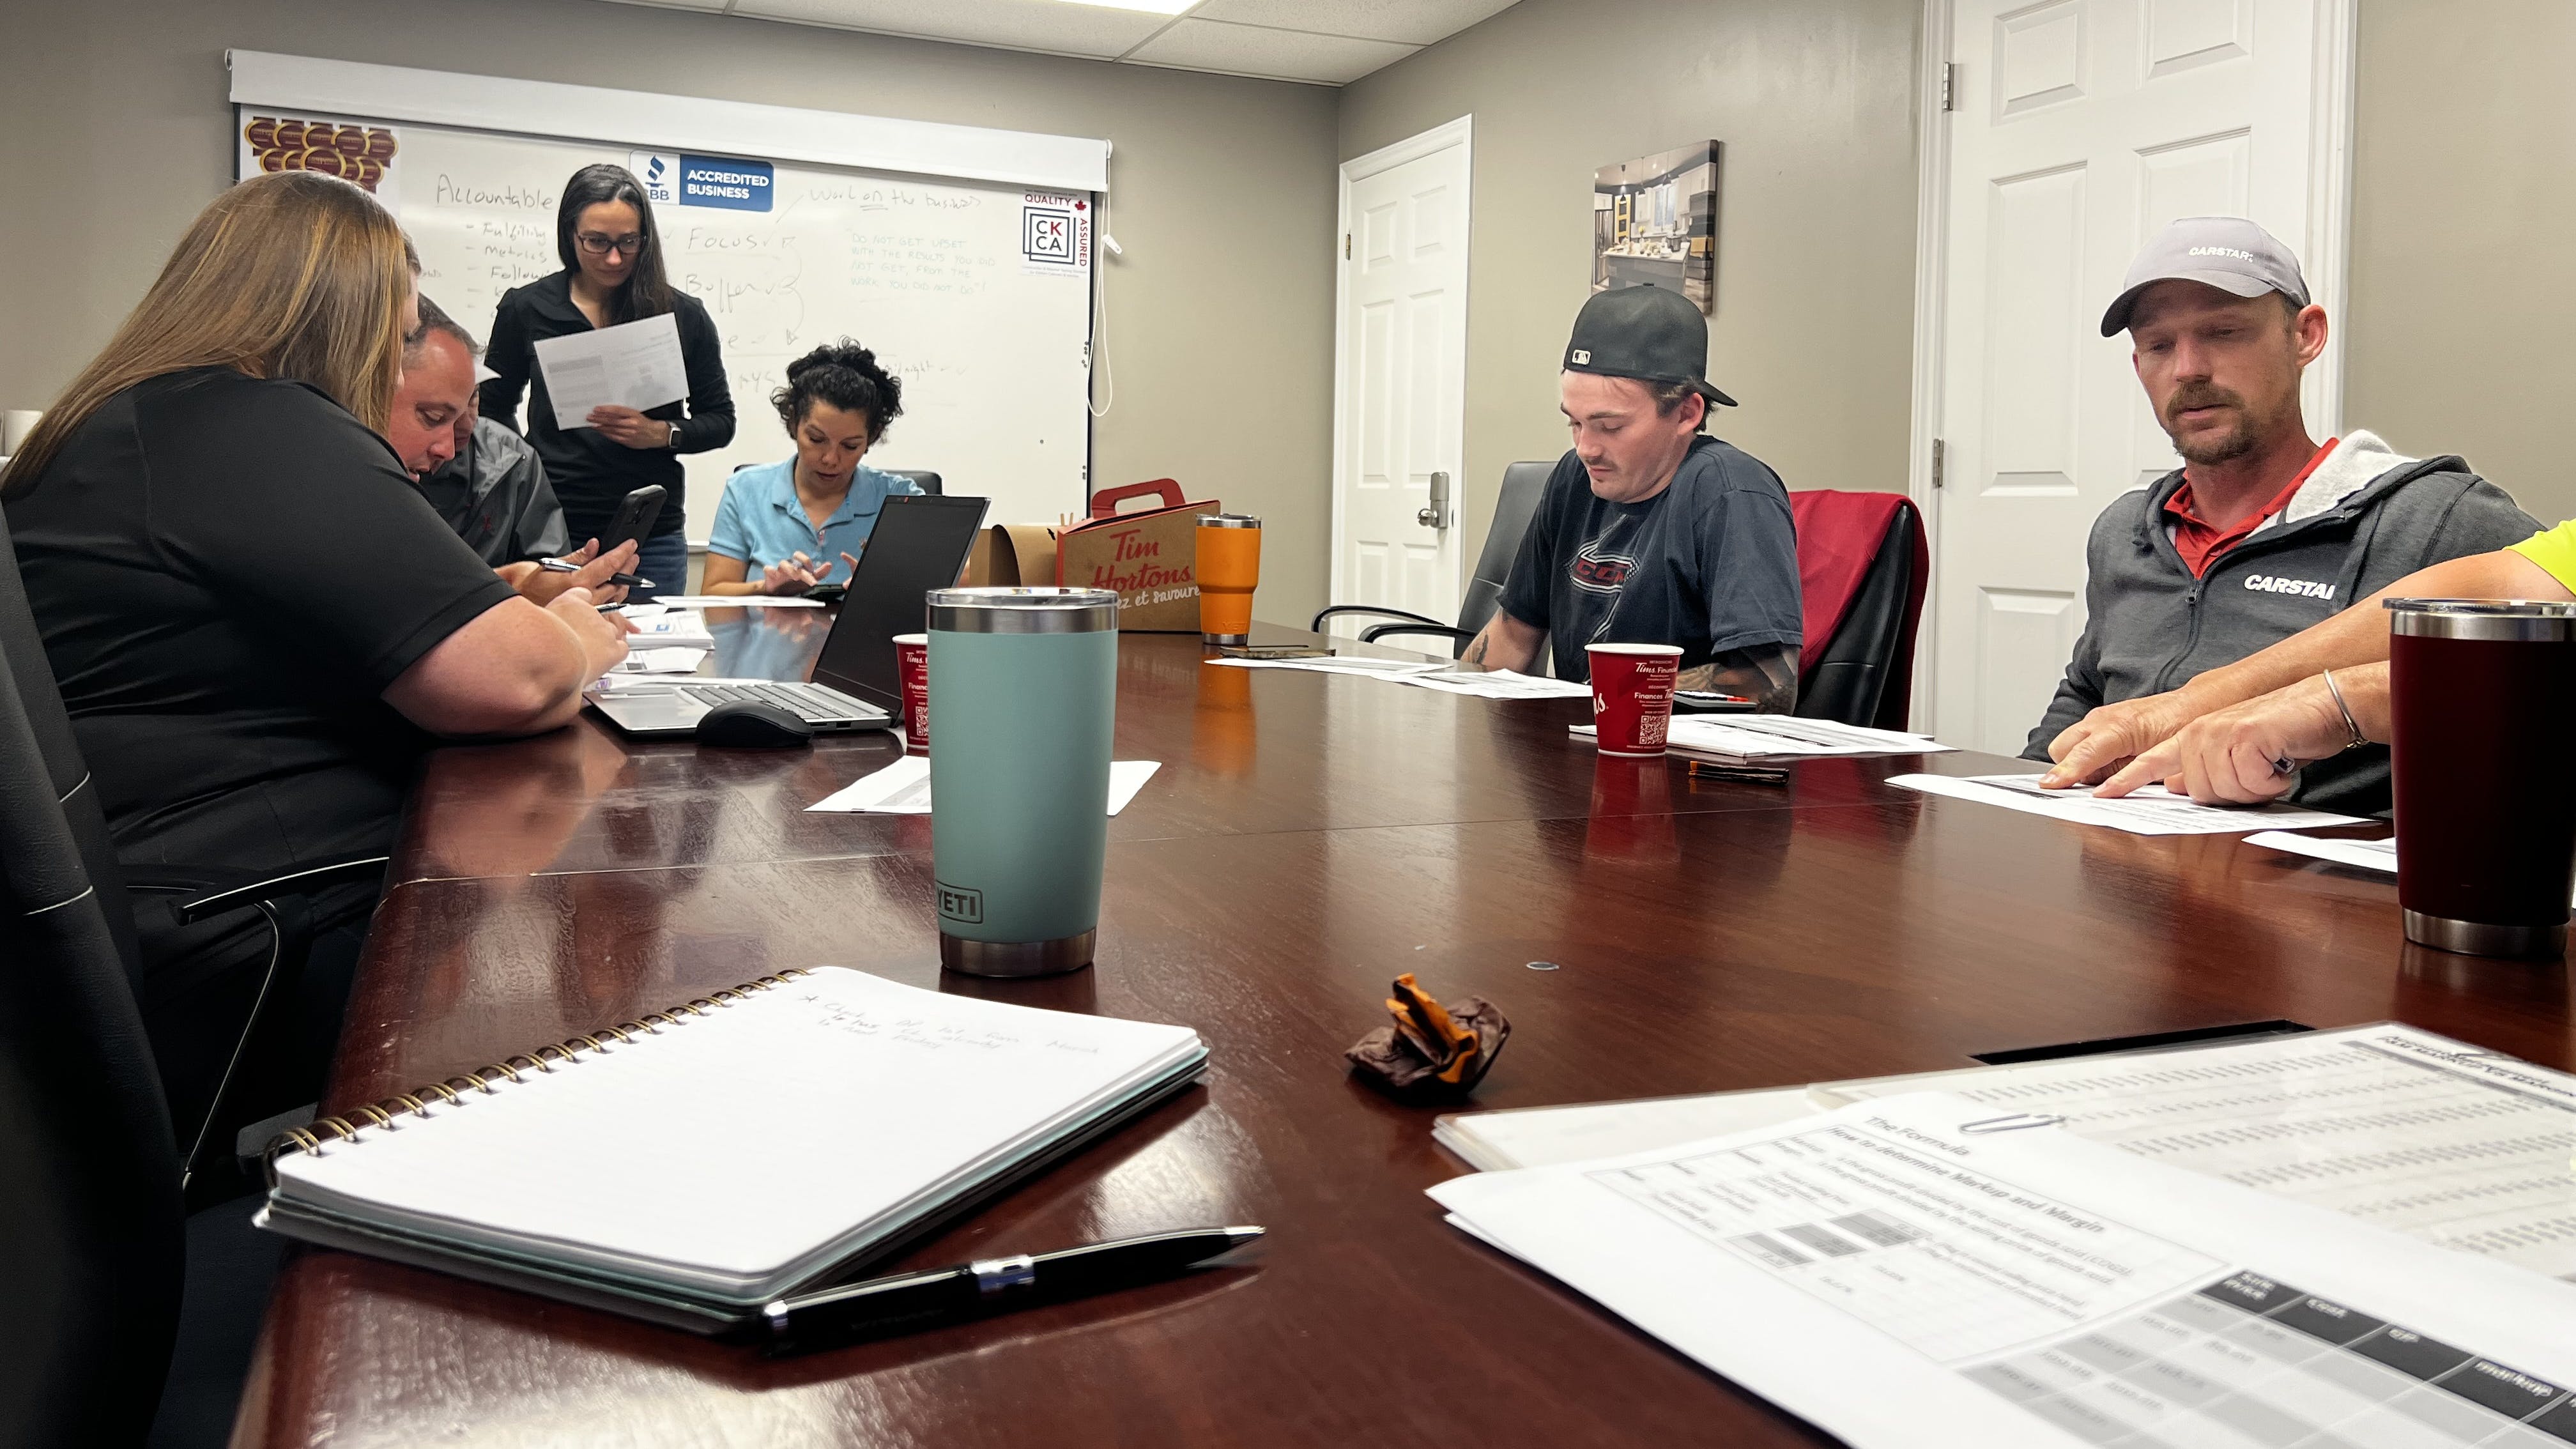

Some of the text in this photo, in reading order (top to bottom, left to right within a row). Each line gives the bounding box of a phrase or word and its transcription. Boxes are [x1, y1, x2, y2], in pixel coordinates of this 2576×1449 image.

[687, 169, 769, 187] ACCREDITED
[436, 173, 553, 210] Accountable
[647, 189, 669, 200] BB
[687, 183, 750, 199] BUSINESS
[1025, 194, 1071, 206] QUALITY
[688, 227, 757, 249] Focus
[900, 237, 924, 247] GET
[882, 249, 900, 259] THE
[1109, 529, 1159, 562] Tim
[1091, 563, 1193, 594] Hortons
[1135, 591, 1150, 606] et
[1153, 585, 1201, 604] savoure
[906, 652, 924, 663] Tims
[1636, 662, 1655, 673] Tims
[908, 682, 928, 690] Financ
[1862, 1116, 1974, 1156] The Formula
[1828, 1127, 1856, 1140] How
[1876, 1145, 1949, 1176] determine
[1951, 1172, 2011, 1199] Markup
[2010, 1195, 2046, 1209] and
[2043, 1206, 2104, 1233] Margin
